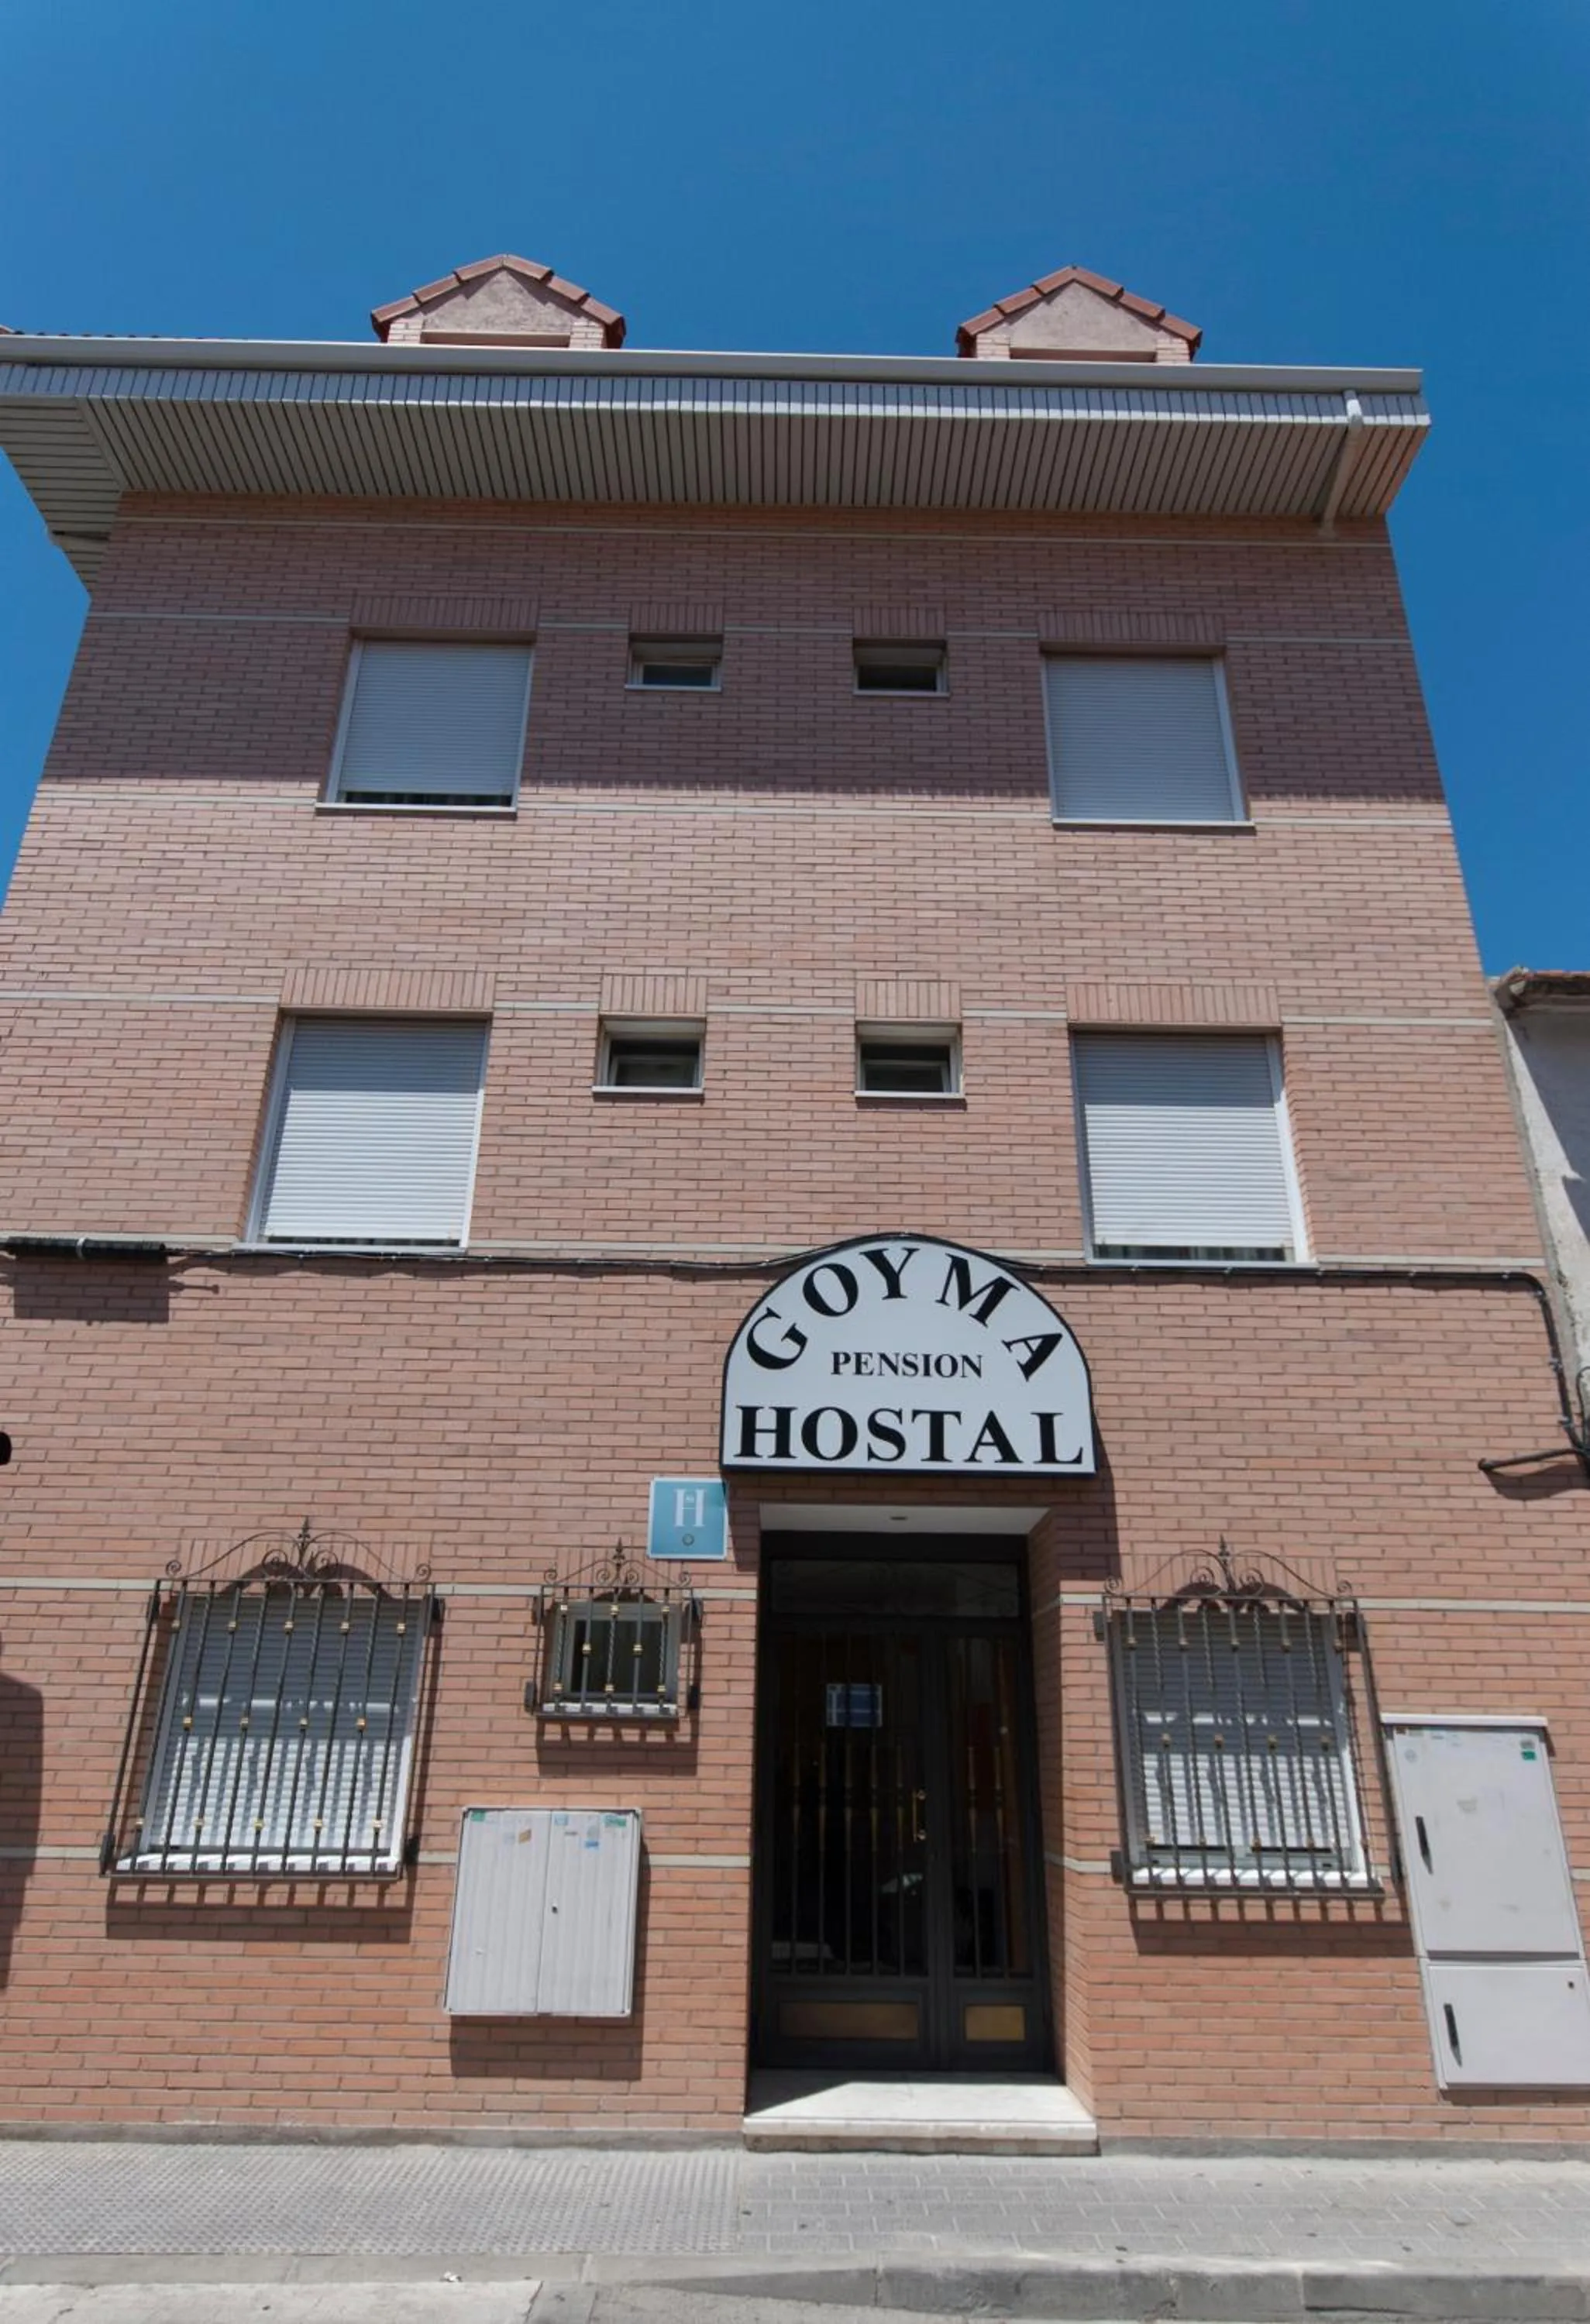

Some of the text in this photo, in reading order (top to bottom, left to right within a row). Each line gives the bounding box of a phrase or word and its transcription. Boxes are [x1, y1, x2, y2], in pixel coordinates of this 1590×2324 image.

[746, 1247, 1063, 1382] GOYMA
[831, 1351, 983, 1378] PENSION
[734, 1405, 1083, 1465] HOSTAL
